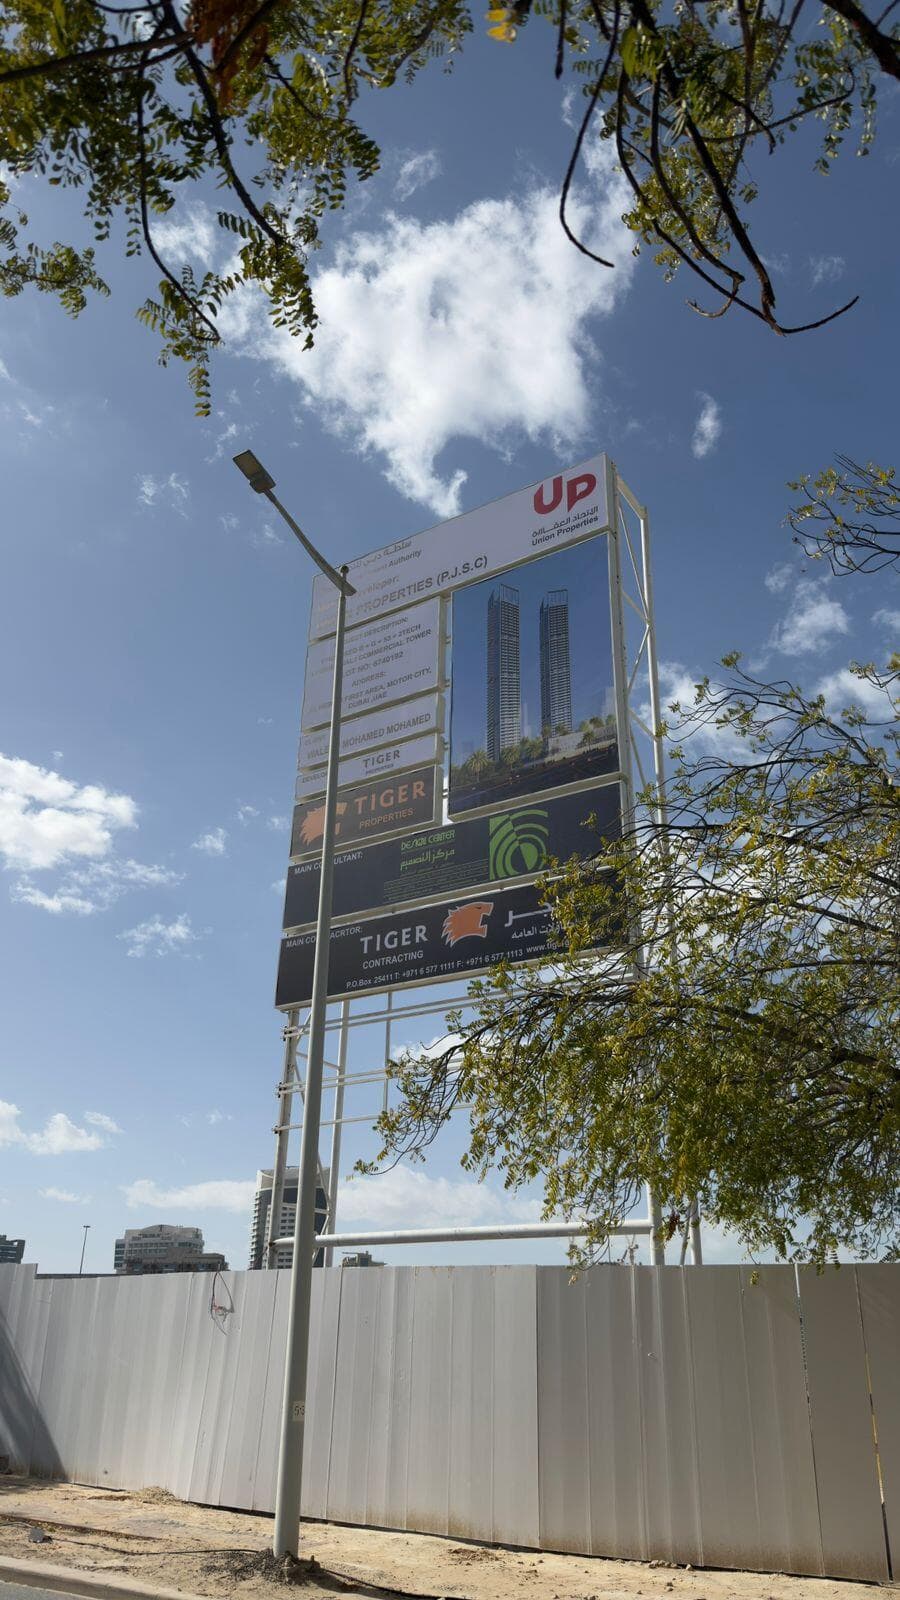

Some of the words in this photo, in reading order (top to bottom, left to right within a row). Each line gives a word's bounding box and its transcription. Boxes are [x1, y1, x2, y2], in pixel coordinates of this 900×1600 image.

[534, 473, 597, 515] UP
[531, 533, 555, 546] Union
[557, 515, 599, 536] Properties
[388, 549, 422, 567] Authority
[437, 555, 488, 586] (P.J.S.C)
[406, 628, 432, 644] TOWER
[387, 674, 413, 688] MOTOR
[341, 729, 385, 747] MOHAMED
[386, 713, 431, 735] MOHAMED
[363, 749, 400, 768] TIGER
[355, 780, 426, 815] TIGER
[359, 808, 415, 829] PROPERTIES
[294, 863, 312, 874] MAIN
[286, 937, 304, 948] MAIN
[360, 924, 429, 954] TIGER
[362, 950, 424, 970] CONTRACTING
[373, 973, 393, 984] 25411
[402, 968, 418, 978] +971
[425, 964, 438, 974] 577
[440, 961, 455, 971] 1111
[456, 959, 464, 968] F:
[466, 956, 483, 966] +971
[491, 951, 504, 962] 577
[507, 948, 524, 959] 1113
